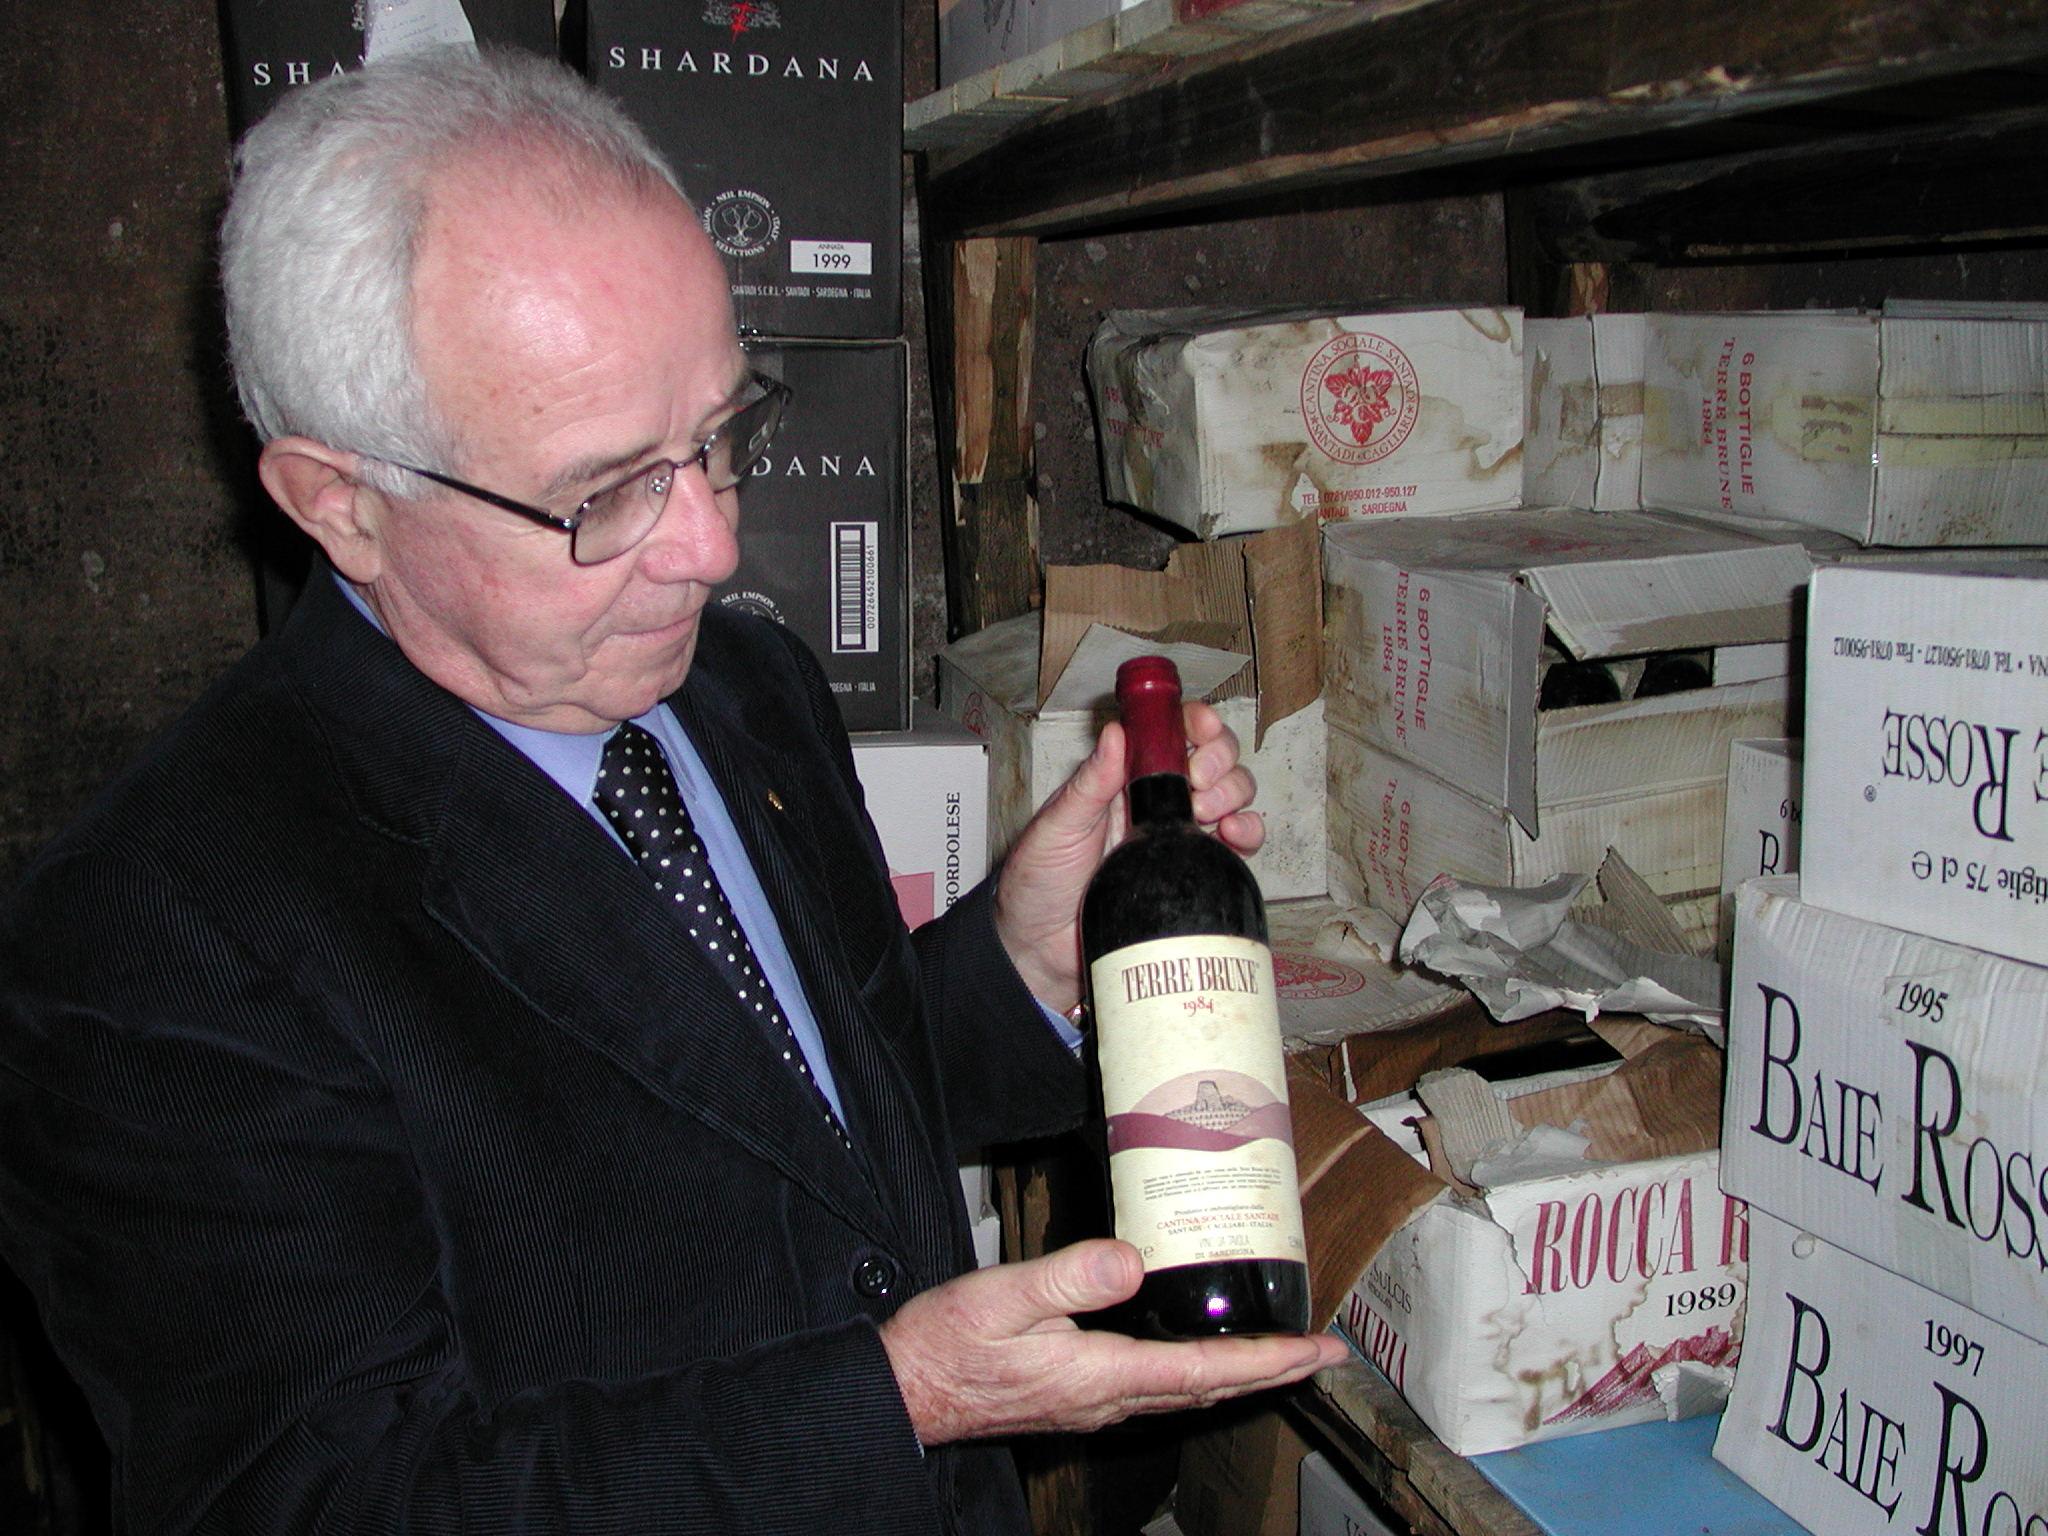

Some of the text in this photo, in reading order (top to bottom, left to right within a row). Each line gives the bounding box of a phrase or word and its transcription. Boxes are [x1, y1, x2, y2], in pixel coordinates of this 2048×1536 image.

[608, 46, 874, 83] SHARDANA
[716, 189, 771, 209] NEIL EMPSON
[772, 216, 781, 241] ITALY
[817, 243, 845, 251] ANNATA
[813, 253, 851, 269] 1999
[731, 284, 757, 296] SANTADI
[785, 286, 811, 298] SANTADI
[815, 286, 852, 298] SARDEGNA
[853, 287, 872, 299] ITALIA
[1305, 336, 1418, 415] CANTINA SOCIALE SANTADI
[1312, 415, 1414, 461] SANTADI CAGLIARI
[1701, 400, 1713, 447] 1984
[1714, 336, 1736, 511] TERRE BRUNE
[1738, 352, 1756, 495] 6 BOTTIGLIE
[1361, 502, 1408, 515] SARDEGNA
[742, 591, 777, 610] EMPSON
[1381, 624, 1395, 672] 1984
[1395, 571, 1410, 744] TERRE BRUNE
[1414, 588, 1431, 731] 6 BOTTIGLIE
[1896, 642, 1915, 663] Fax
[858, 682, 876, 692] ITALIA
[1882, 706, 2021, 843] ROSSE
[1400, 800, 1411, 815] 6
[946, 791, 962, 908] BORDOLESE
[1966, 862, 1989, 893] 75
[1121, 957, 1193, 1004] TERRE
[1196, 956, 1259, 995] BRUNE
[1183, 995, 1214, 1017] 1984
[1897, 982, 1949, 1024] 1995
[1750, 981, 1884, 1197] BAIE
[1156, 1217, 1202, 1231] CANTINA
[1244, 1211, 1280, 1222] SANTADI
[1520, 1178, 1699, 1296] ROCCA
[1664, 1282, 1738, 1318] 1989
[1923, 1319, 1986, 1377] 1997
[1766, 1291, 1907, 1524] BAIE
